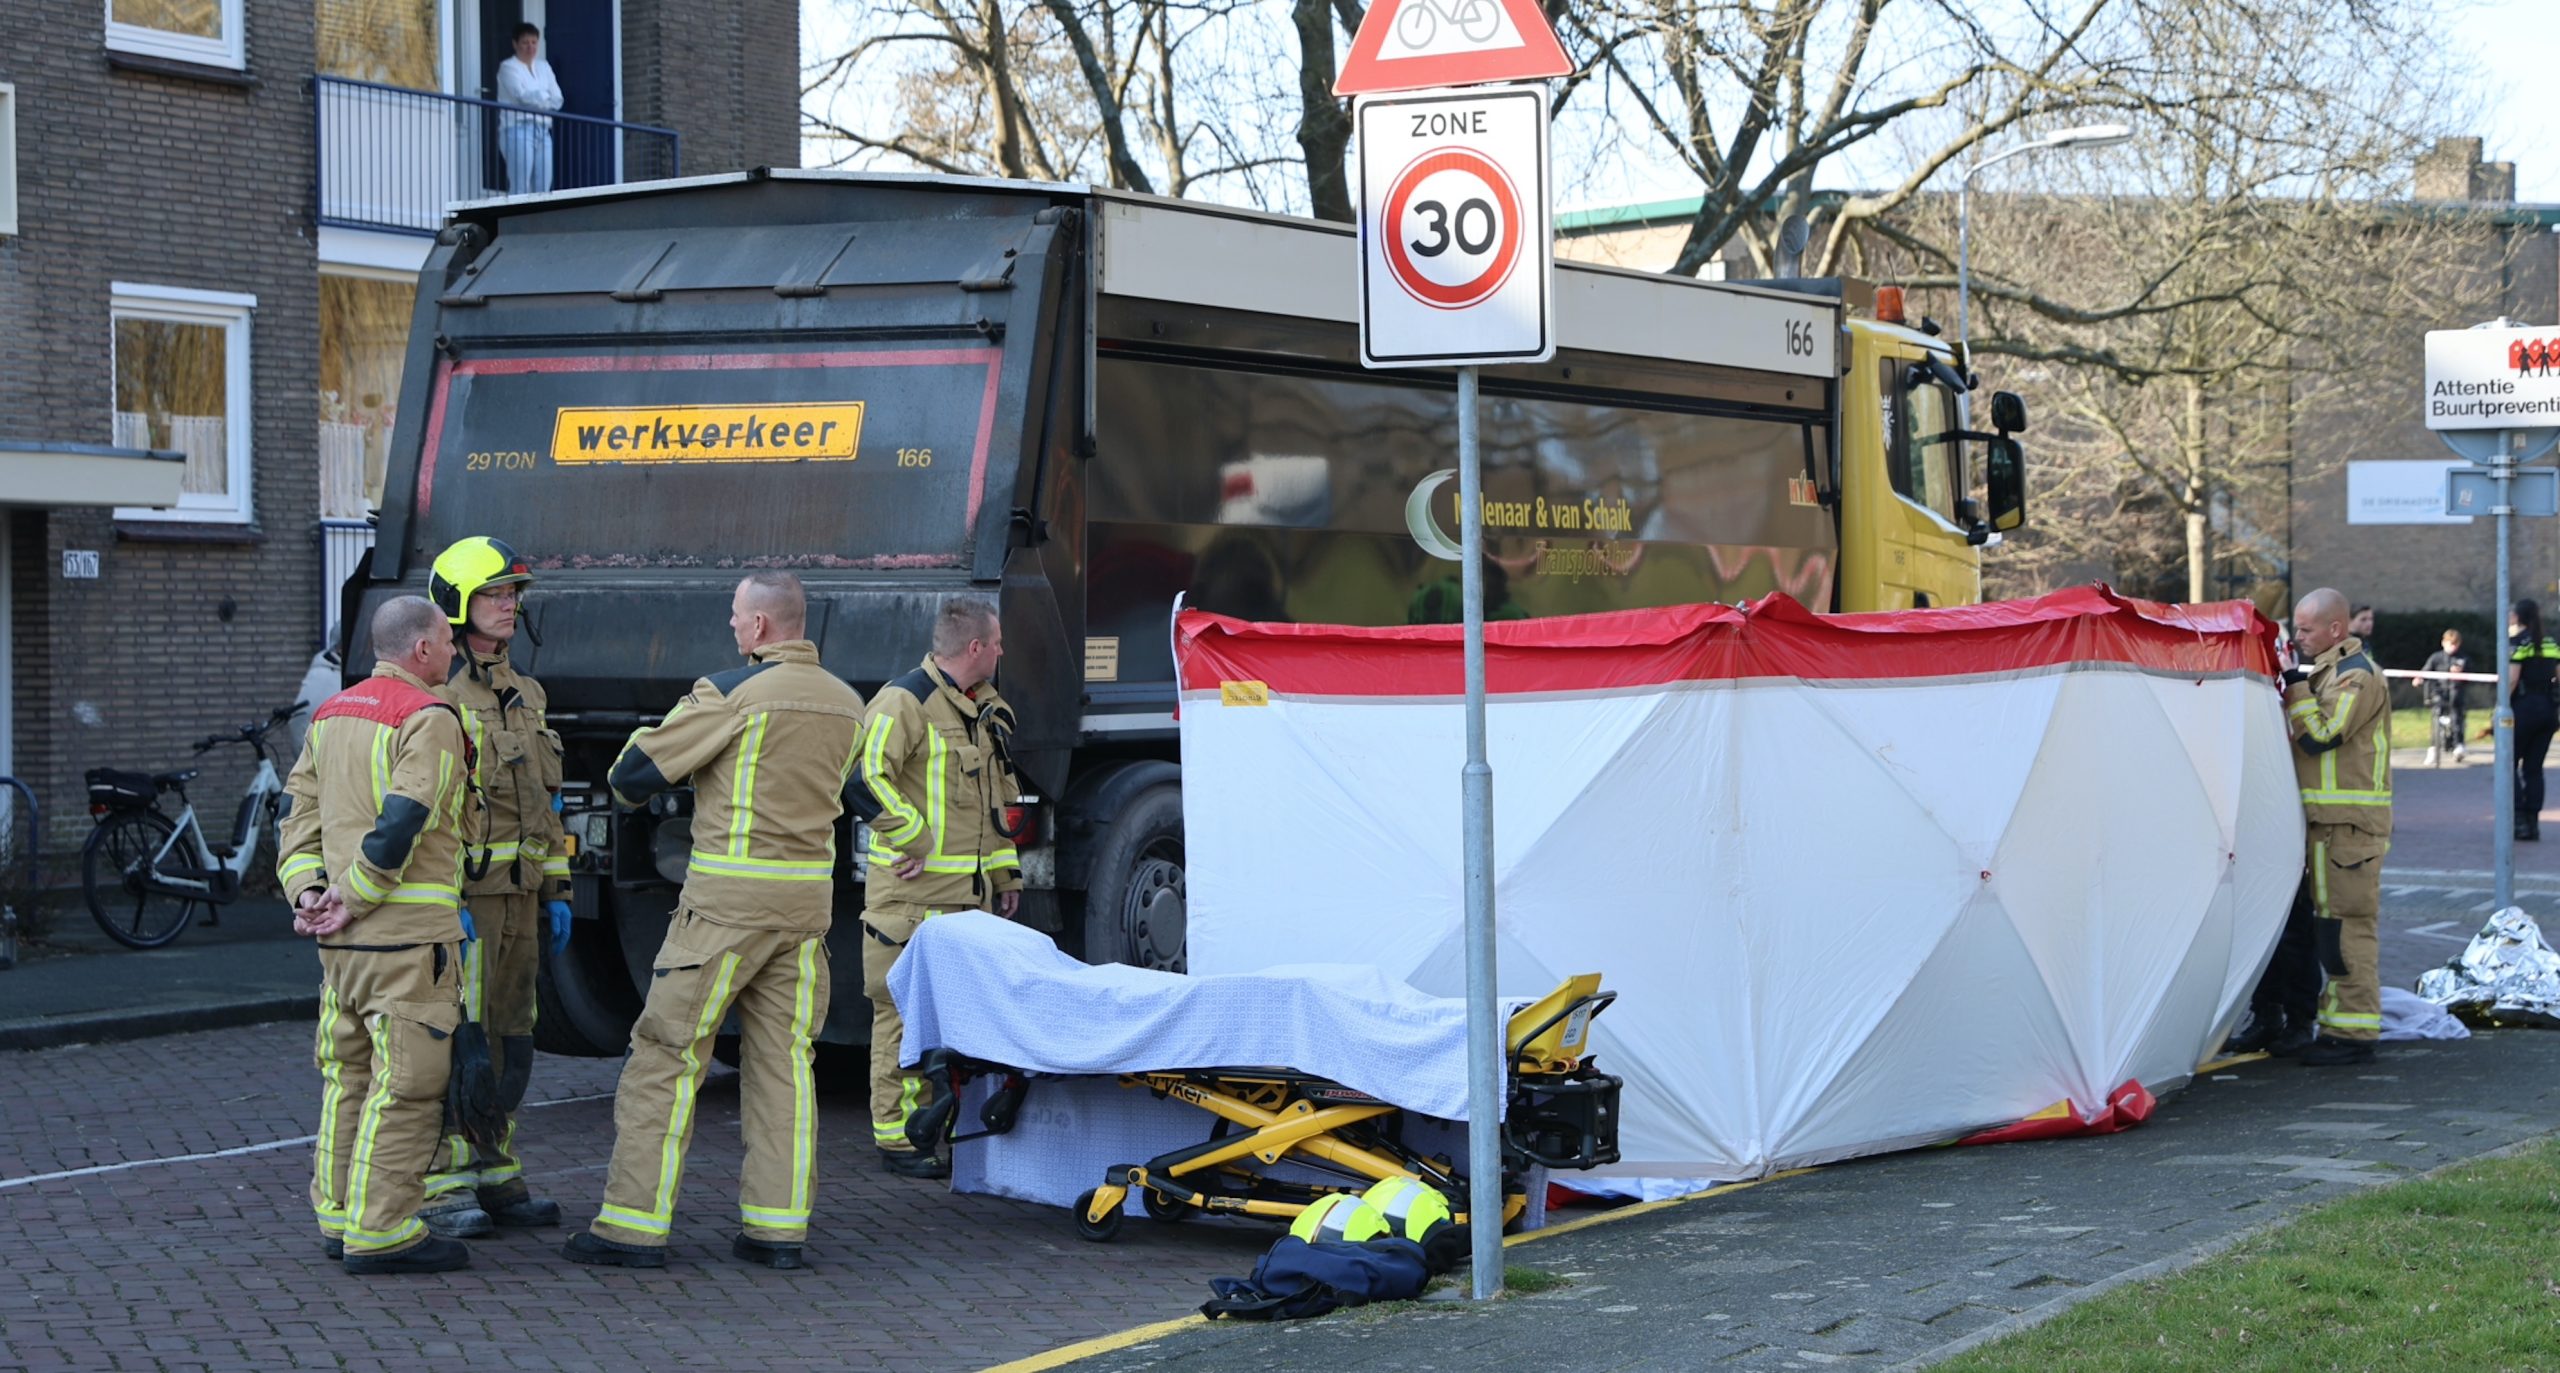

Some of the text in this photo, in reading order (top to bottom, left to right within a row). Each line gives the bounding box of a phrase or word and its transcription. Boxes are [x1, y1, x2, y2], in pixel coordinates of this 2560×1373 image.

[1411, 111, 1487, 137] ZONE
[1410, 198, 1496, 257] 30
[1785, 319, 1814, 357] 166
[2433, 379, 2515, 396] Attentie
[577, 415, 838, 452] werkverkeer
[466, 451, 536, 471] 29 TON
[896, 448, 931, 467] 166
[1454, 491, 1632, 531] Mlenaar & van Schaik
[1536, 541, 1611, 584] Transport
